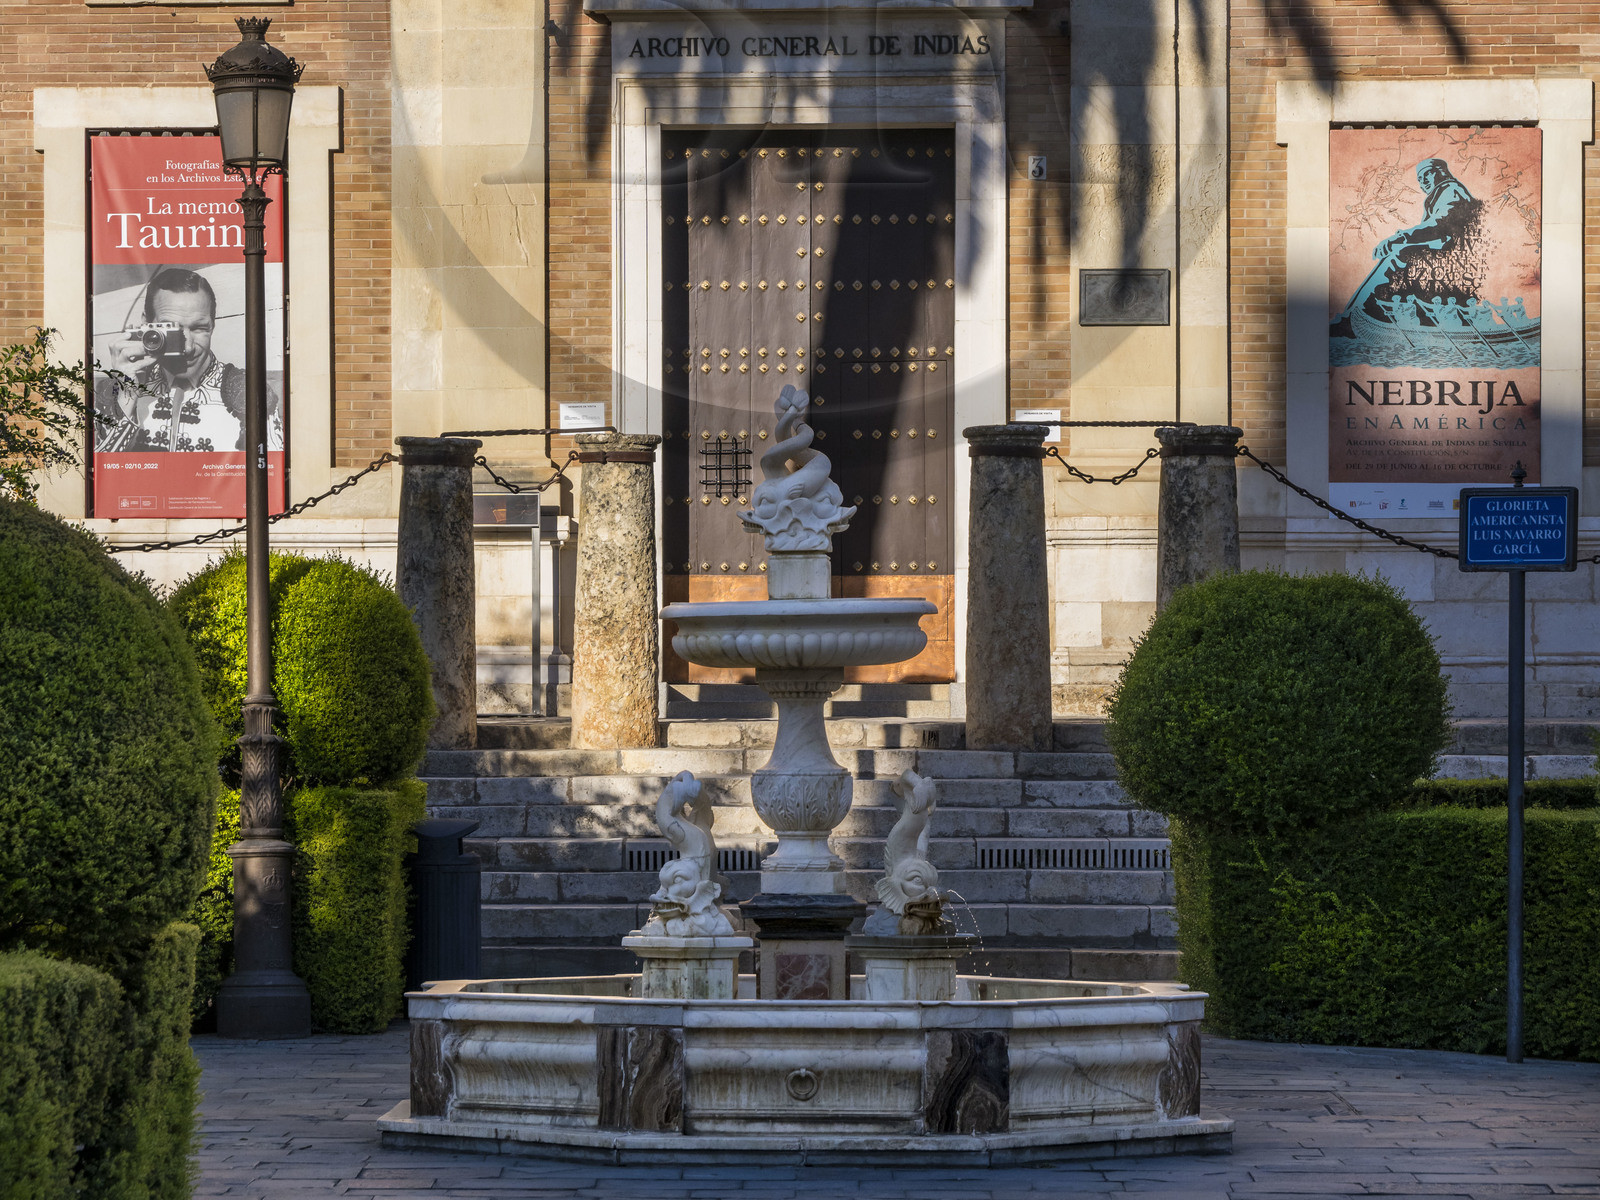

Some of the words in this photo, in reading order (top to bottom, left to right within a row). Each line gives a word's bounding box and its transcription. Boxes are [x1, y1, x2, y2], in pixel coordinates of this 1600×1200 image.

[629, 36, 730, 58] ARCHIVO
[742, 35, 858, 57] GENERAL
[868, 35, 901, 56] DE
[914, 34, 991, 56] INDIAS
[165, 160, 220, 172] Fotografías
[1031, 157, 1044, 178] 3
[161, 174, 175, 183] los
[177, 174, 221, 183] Archivos
[147, 197, 173, 215] La
[178, 201, 267, 215] memo
[107, 213, 267, 249] Taurin
[1345, 380, 1527, 414] NEBRIJA
[1346, 417, 1378, 430] EN
[1389, 413, 1527, 430] AMÉRICA
[1345, 439, 1386, 447] ARCHIVO
[1389, 439, 1429, 447] GENERAL
[1432, 439, 1444, 447] DE
[1446, 439, 1476, 447] INDIAS
[1478, 439, 1490, 447] DE
[1493, 439, 1527, 447] SEVILLA
[1345, 463, 1362, 471] DEL
[1376, 463, 1388, 471] DE
[1389, 463, 1417, 472] JUNIO
[1420, 463, 1431, 471] AL
[1433, 463, 1442, 471] 16
[1444, 463, 1456, 471] DE
[1459, 463, 1503, 471] OCTUBRE
[1486, 500, 1549, 511] GLORIETA
[1471, 515, 1564, 525] AMERICANISTA
[1474, 530, 1501, 540] LUIS
[1504, 529, 1562, 540] NAVARRO
[1493, 540, 1541, 555] GARCÍA
